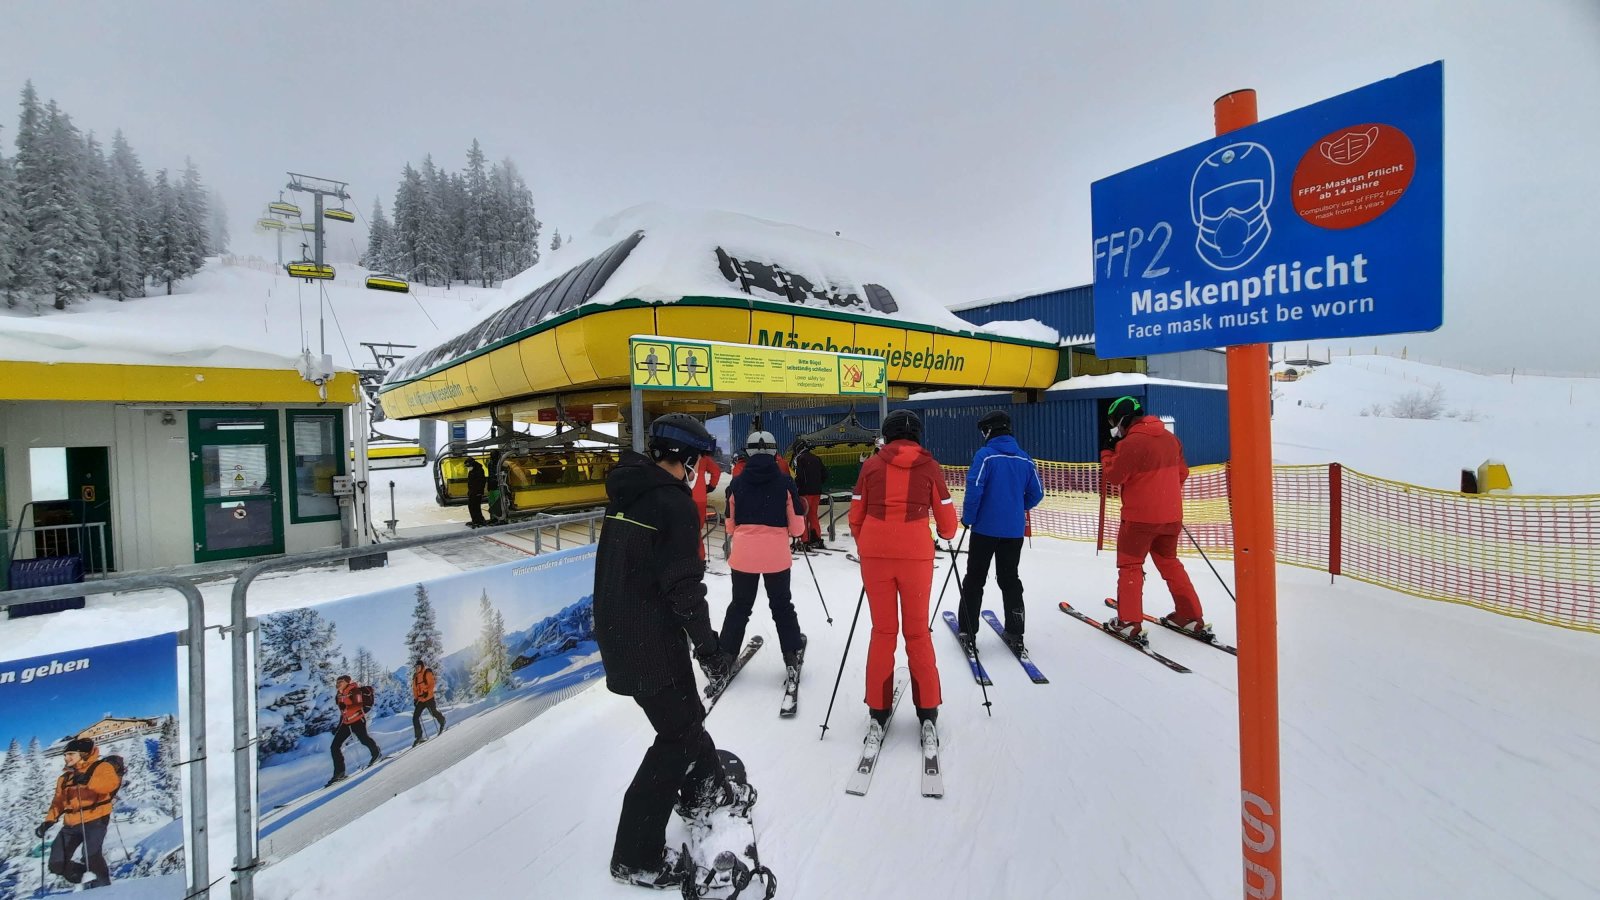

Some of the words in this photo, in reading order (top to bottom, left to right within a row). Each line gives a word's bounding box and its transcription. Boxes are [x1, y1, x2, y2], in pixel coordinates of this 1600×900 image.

[1298, 175, 1365, 196] FFP2-Masken
[1367, 164, 1404, 179] Pflicht
[1319, 191, 1332, 200] ab
[1335, 188, 1347, 196] 14
[1350, 180, 1380, 193] Jahre
[1300, 203, 1340, 217] Compulsory
[1365, 192, 1385, 200] FFP2
[1386, 188, 1403, 196] face
[1315, 211, 1334, 220] mask
[1335, 208, 1352, 216] from
[1364, 200, 1385, 211] years
[1092, 221, 1173, 284] FFP2
[1131, 253, 1369, 316] Maskenpflicht
[1127, 323, 1163, 339] Face
[1167, 314, 1213, 334] mask
[1219, 306, 1269, 329] must
[1276, 303, 1304, 322] be
[1311, 296, 1375, 319] worn
[20, 658, 90, 684] gehen
